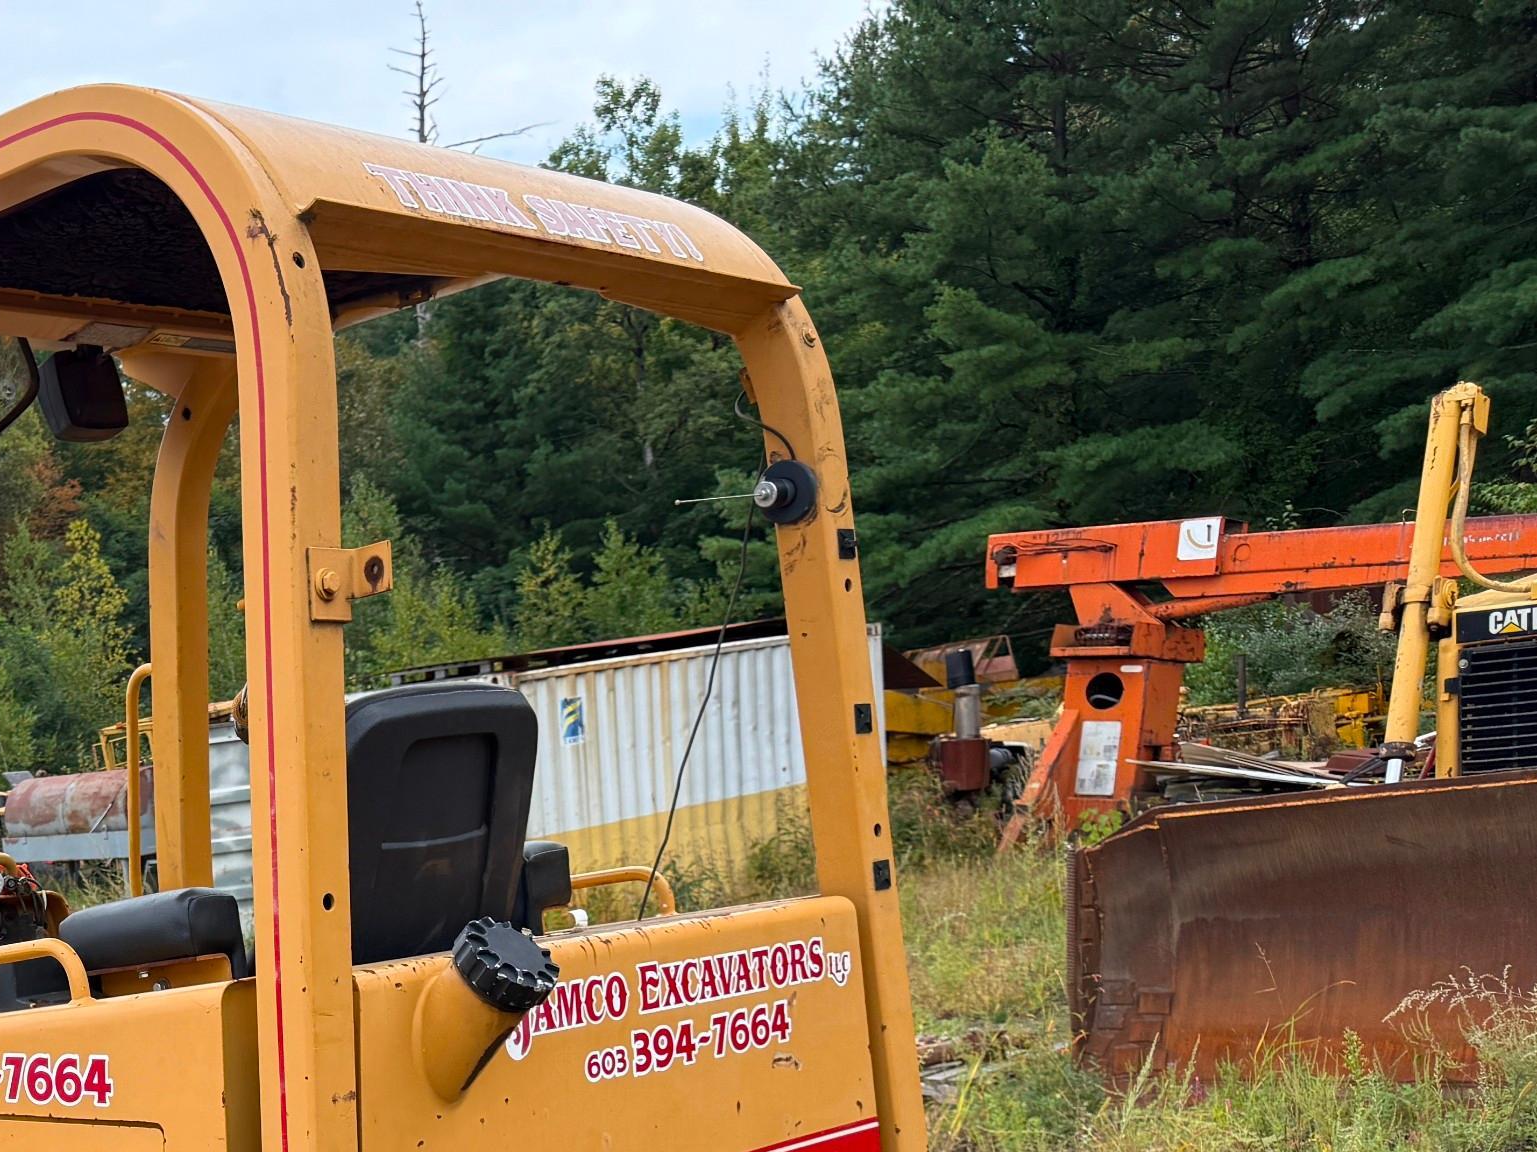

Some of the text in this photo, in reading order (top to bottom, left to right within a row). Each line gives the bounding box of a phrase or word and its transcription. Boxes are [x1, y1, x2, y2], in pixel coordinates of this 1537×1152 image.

[362, 162, 536, 230] THINK
[508, 939, 850, 1058] JAMCO EXCAVATORS LLC
[585, 1049, 628, 1080] 603
